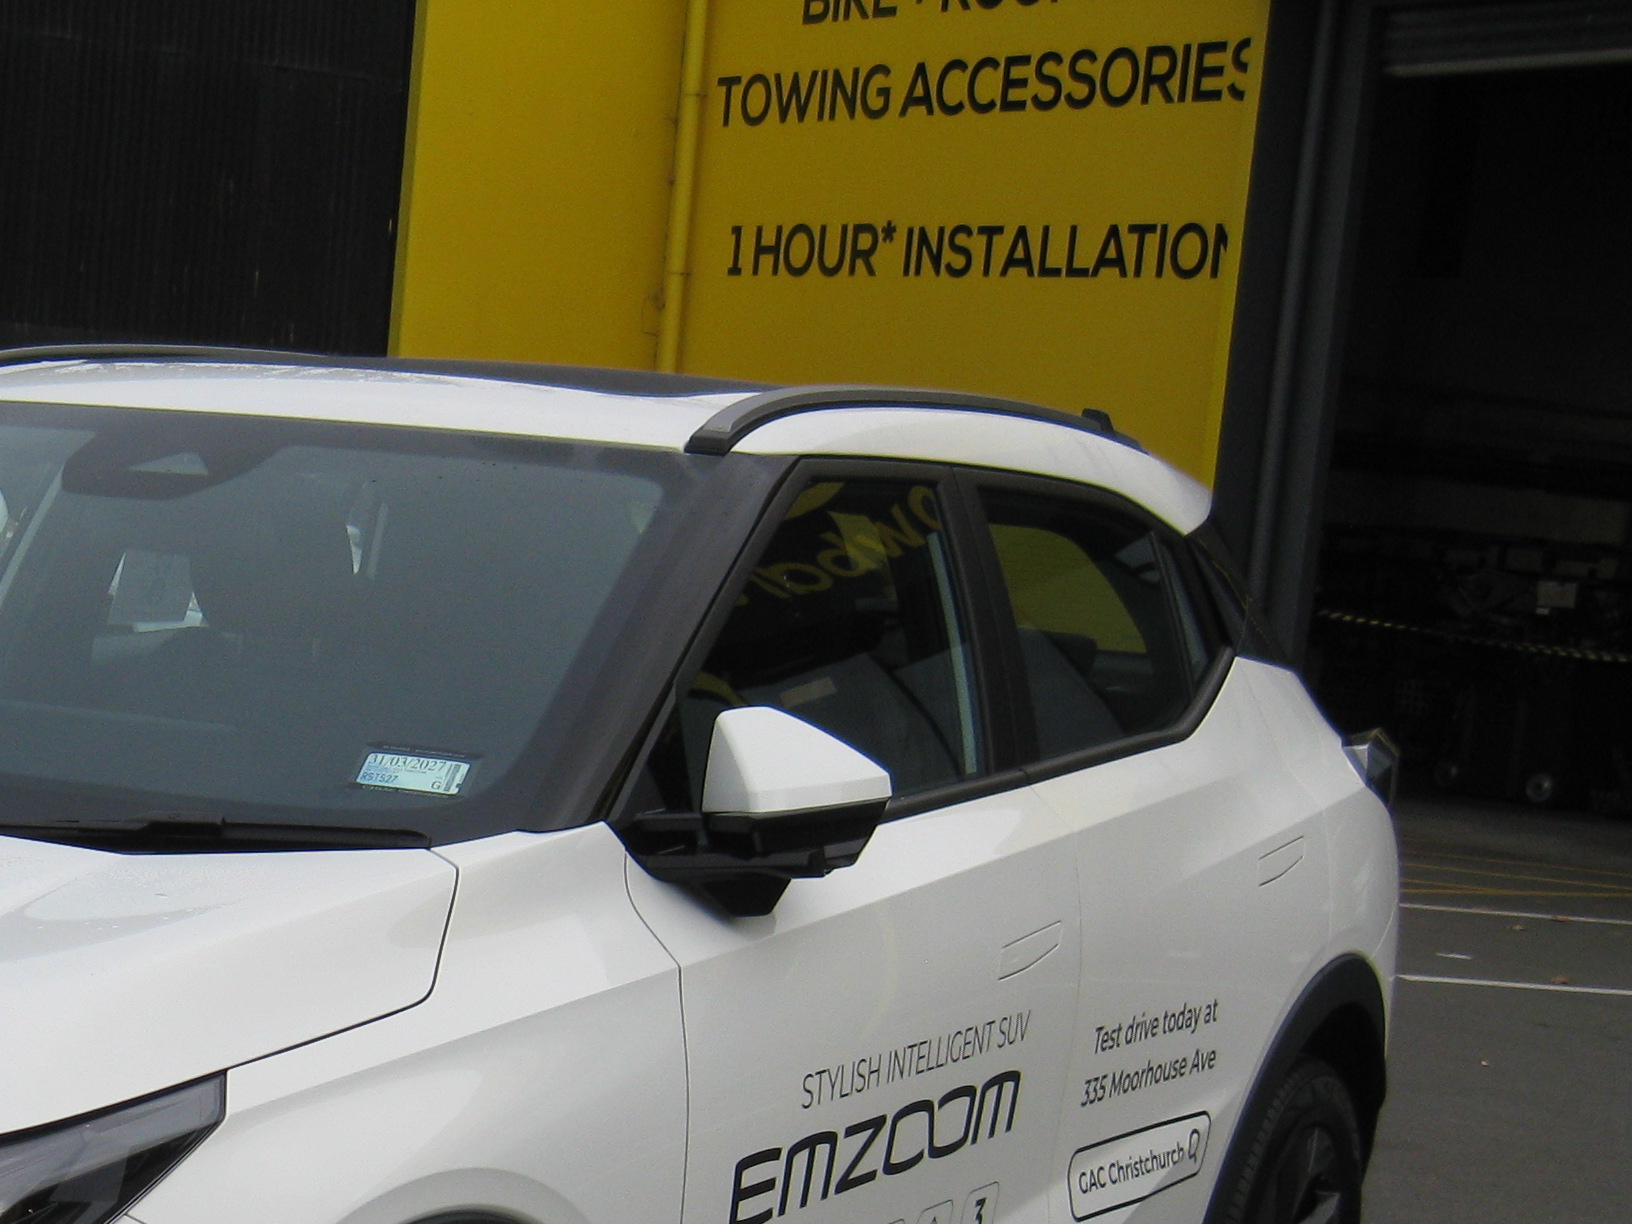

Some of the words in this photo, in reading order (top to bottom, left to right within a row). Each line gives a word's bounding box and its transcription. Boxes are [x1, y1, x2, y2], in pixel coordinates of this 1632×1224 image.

[717, 62, 892, 127] TOWING
[361, 772, 399, 784] RST527
[1094, 1023, 1123, 1054] Test
[1124, 1011, 1160, 1046] drive
[1162, 1002, 1202, 1034] today
[1204, 998, 1218, 1025] at
[801, 1053, 882, 1109] STYLISH
[886, 1020, 996, 1085] INTELLIGENT
[997, 1009, 1032, 1049] SUV
[1081, 1073, 1109, 1108] 335
[1109, 1059, 1188, 1098] Moorhouse
[1188, 1048, 1217, 1075] Ave
[1078, 1166, 1107, 1194] GAC
[1108, 1141, 1185, 1185] Christchurch
